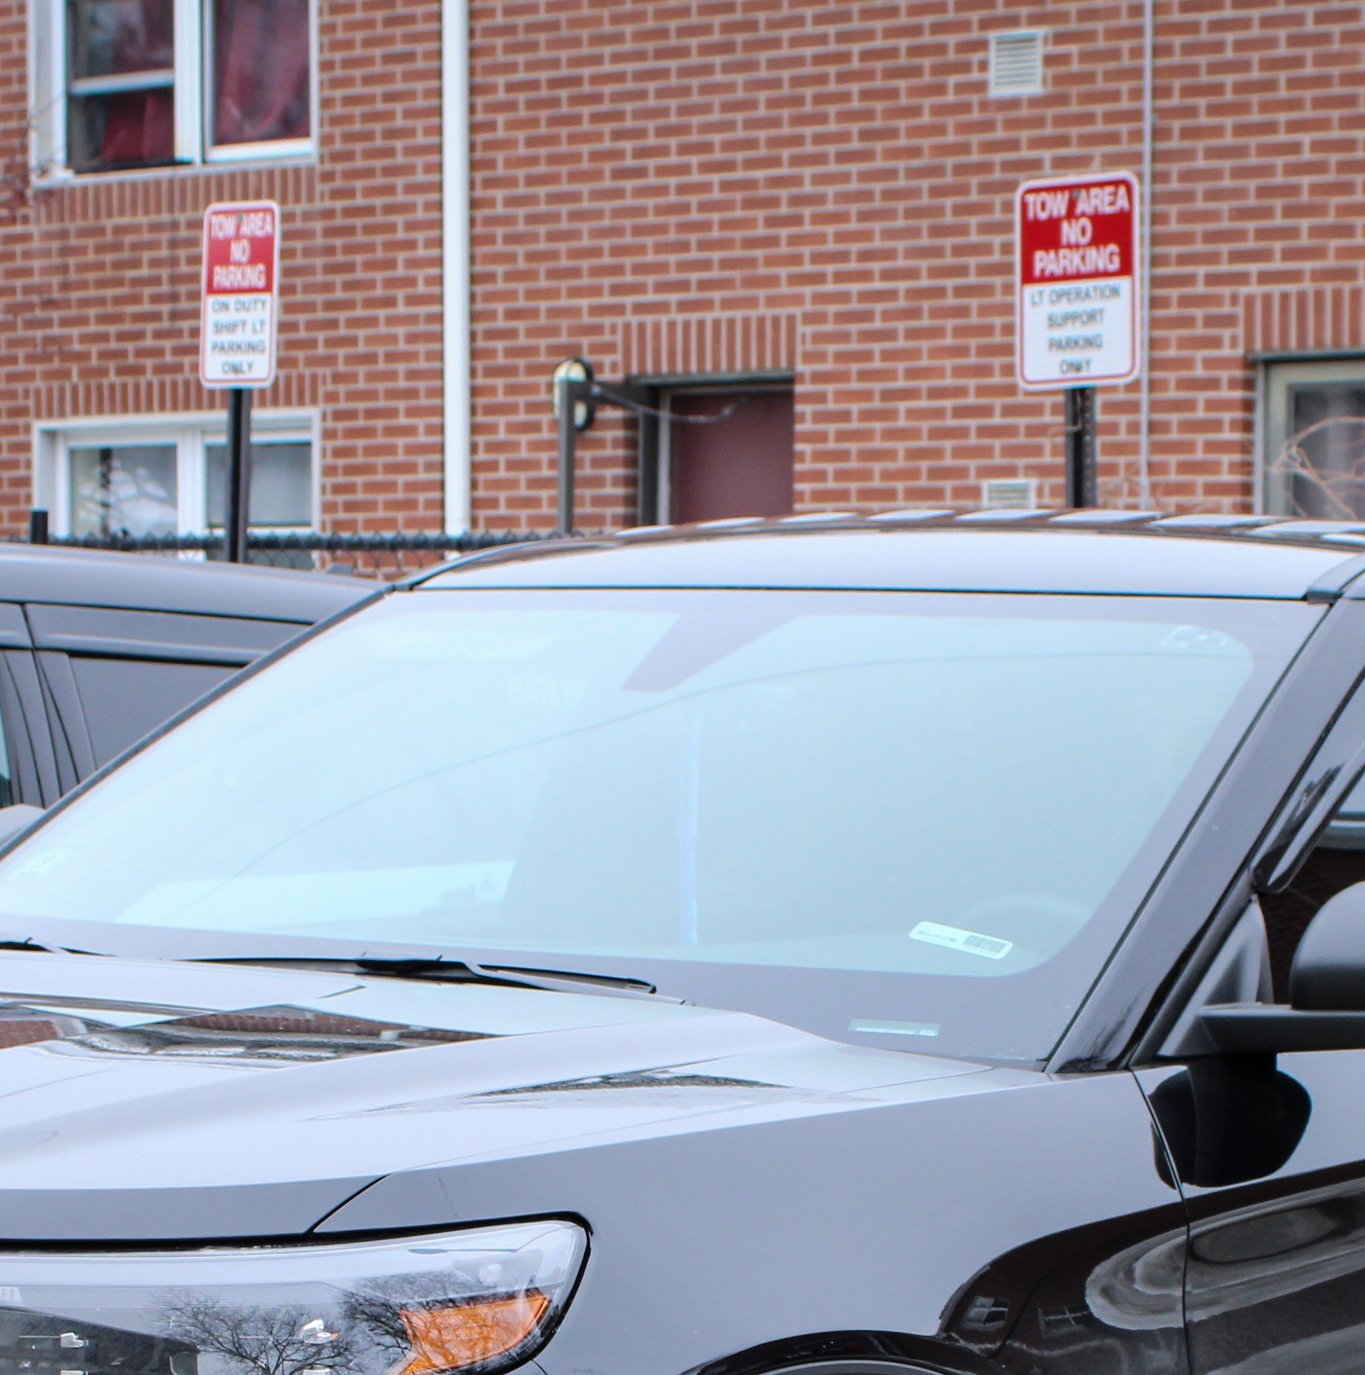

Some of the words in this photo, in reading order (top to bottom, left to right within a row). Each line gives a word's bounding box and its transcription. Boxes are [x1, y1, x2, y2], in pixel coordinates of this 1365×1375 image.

[1024, 190, 1070, 221] TOW
[1075, 185, 1130, 217] AREA
[211, 214, 235, 240] TOW
[239, 212, 273, 237] AREA
[1061, 217, 1093, 246] NO
[230, 238, 251, 264] NO
[1033, 244, 1120, 278] PARKING
[213, 264, 266, 290] PARKING
[234, 297, 267, 313] DUTY
[1048, 308, 1105, 329] SUPPORT
[211, 340, 265, 355] PARKING
[1049, 333, 1103, 351] PARKING
